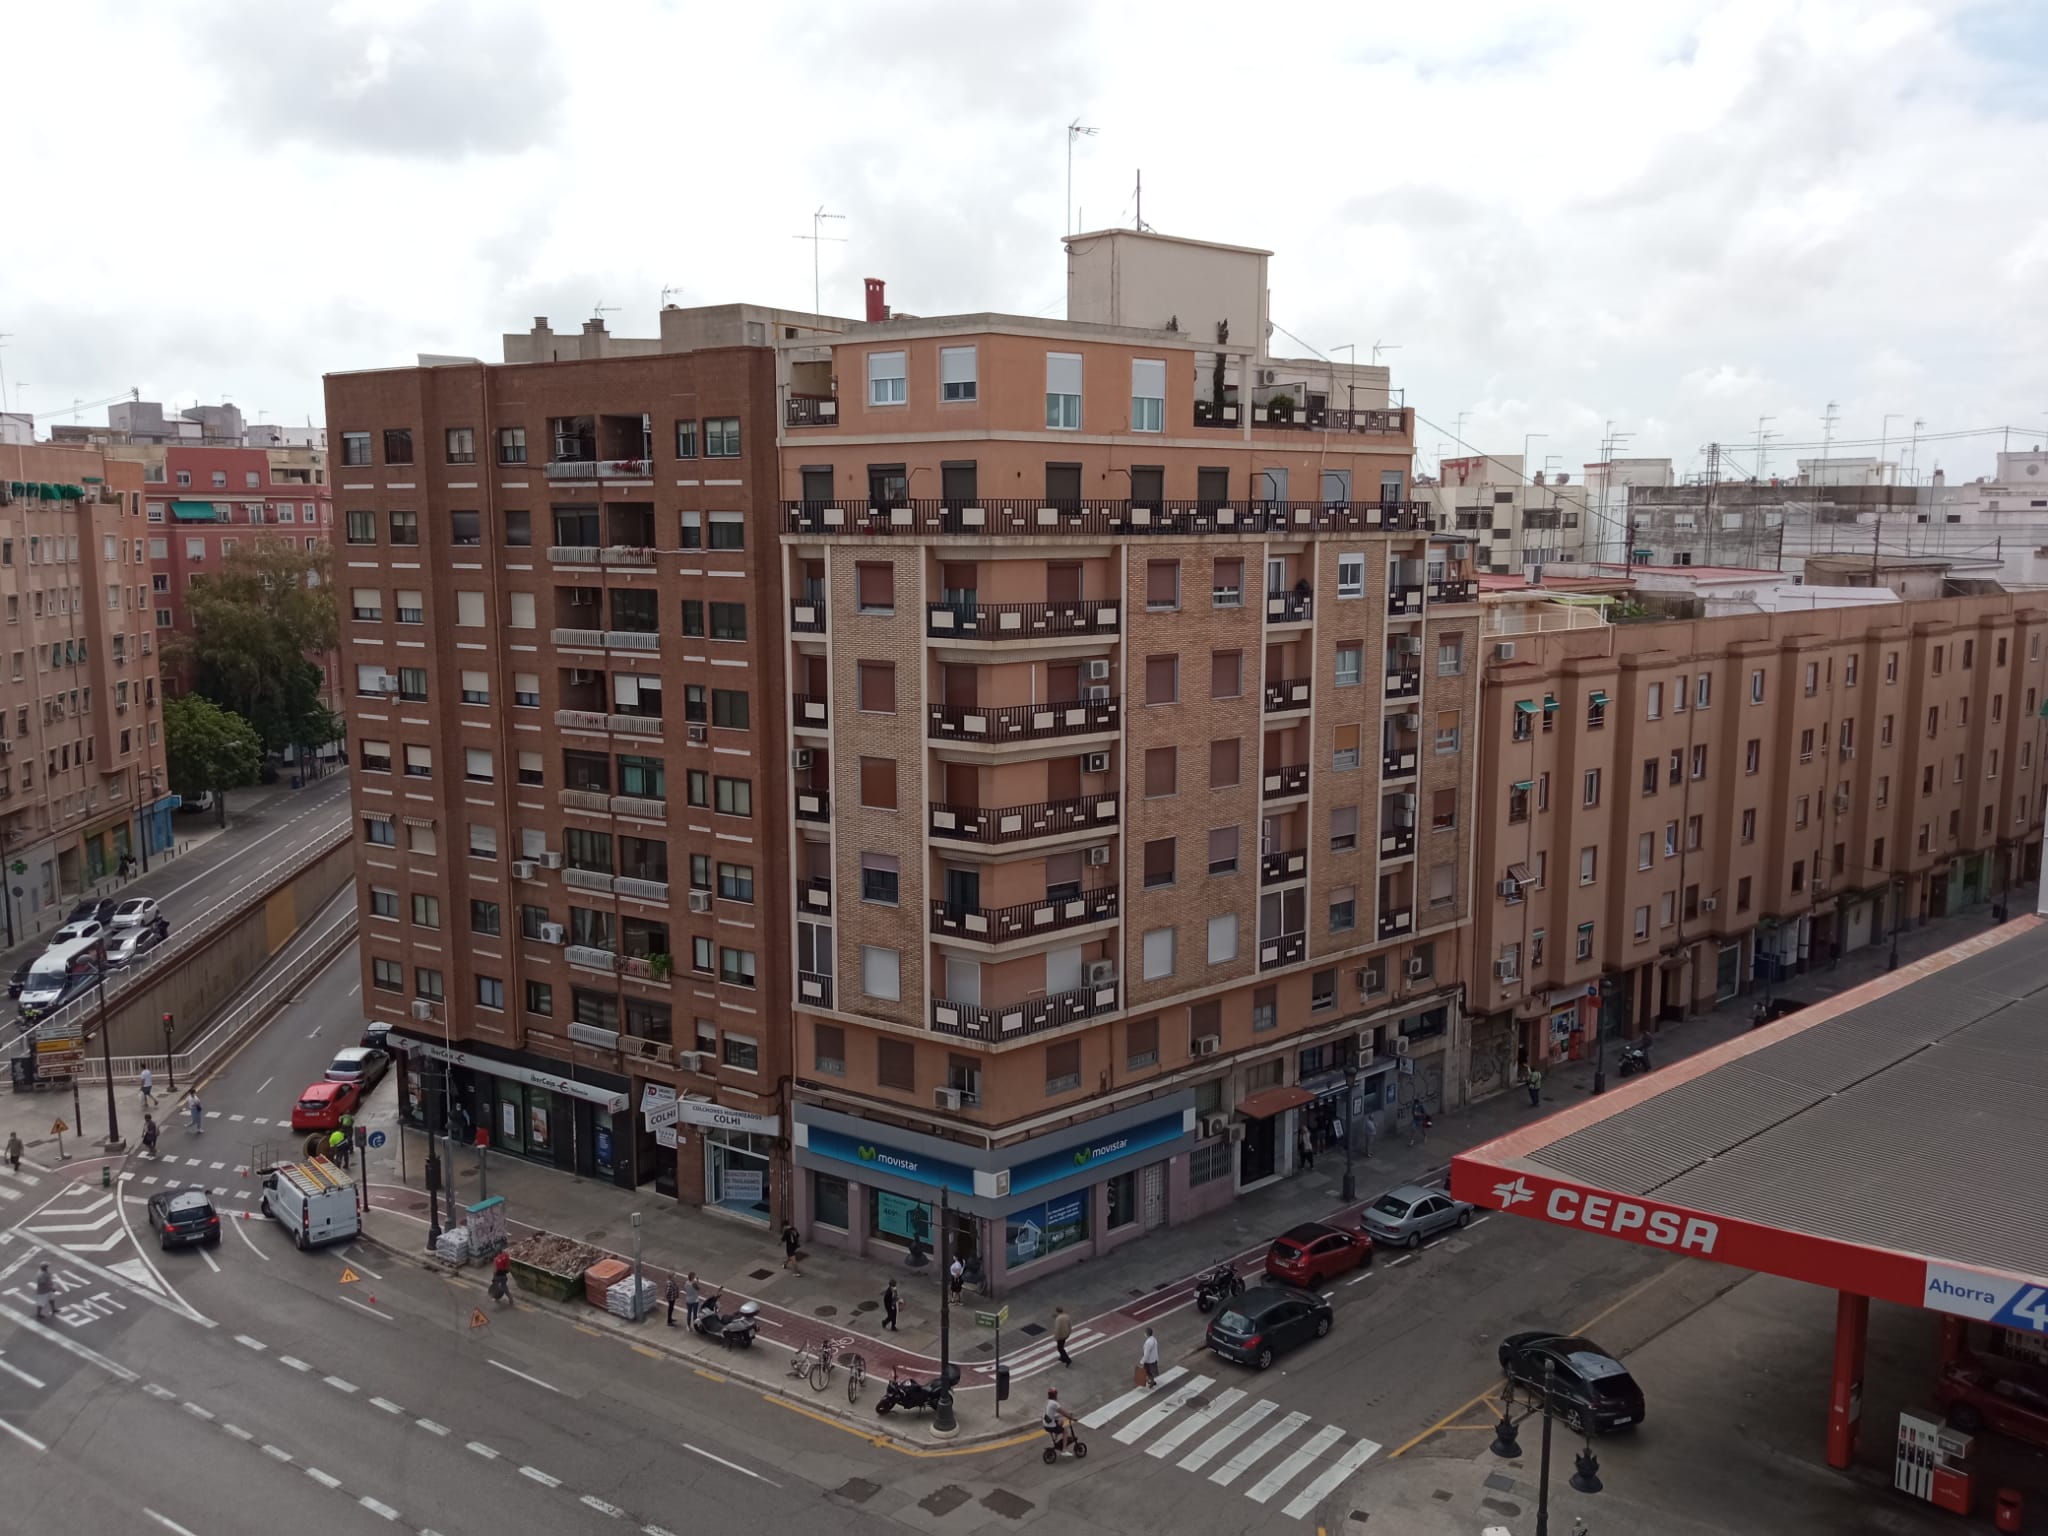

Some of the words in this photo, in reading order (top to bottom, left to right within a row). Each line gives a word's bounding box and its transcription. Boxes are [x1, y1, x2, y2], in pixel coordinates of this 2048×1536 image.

[650, 1110, 676, 1125] COLHI
[713, 1114, 741, 1125] COLHI
[1092, 1139, 1128, 1159] movistar
[878, 1154, 918, 1172] movistar
[1546, 1188, 1719, 1254] CEPSA
[2, 1269, 91, 1305] TXI
[1928, 1278, 1995, 1305] Ahorra
[55, 1291, 127, 1327] EMT
